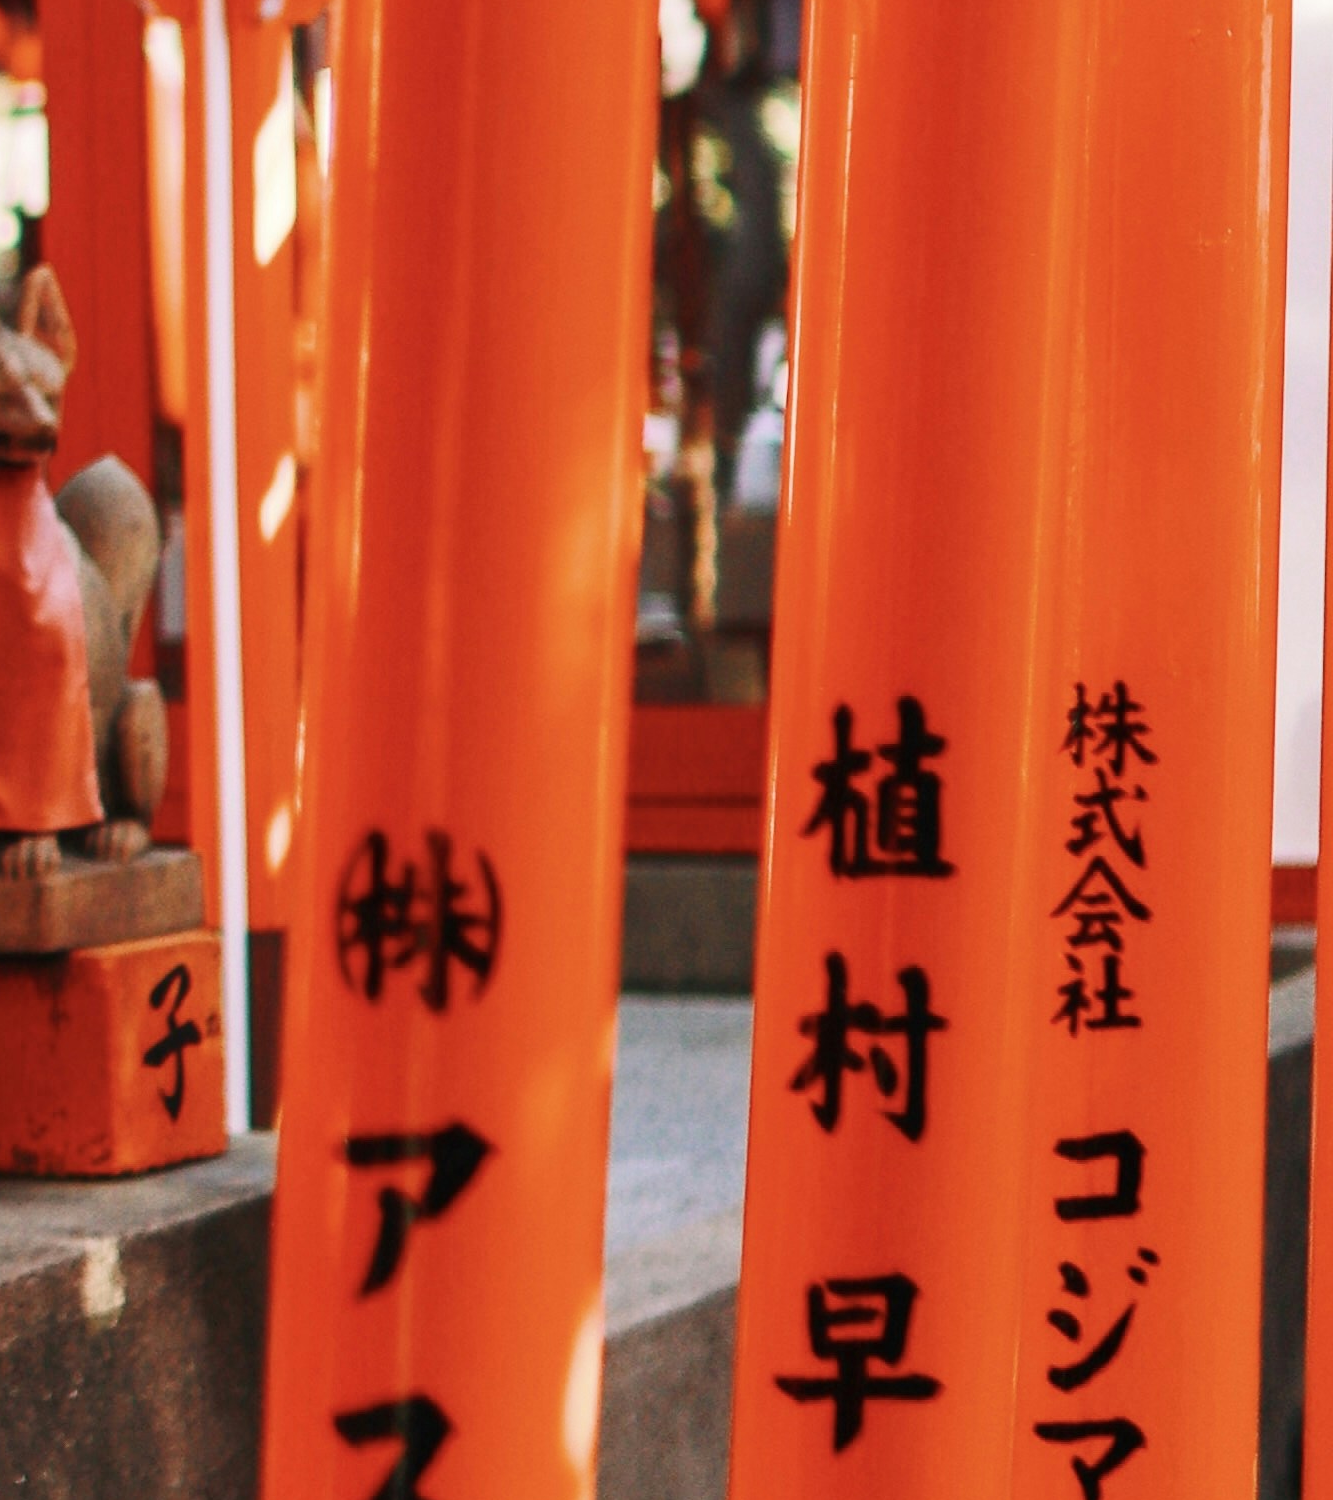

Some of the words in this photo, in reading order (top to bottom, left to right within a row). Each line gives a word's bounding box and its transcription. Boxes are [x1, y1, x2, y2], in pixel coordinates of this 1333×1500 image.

[1050, 680, 1158, 1038] 株式会社
[142, 962, 202, 1123] 子
